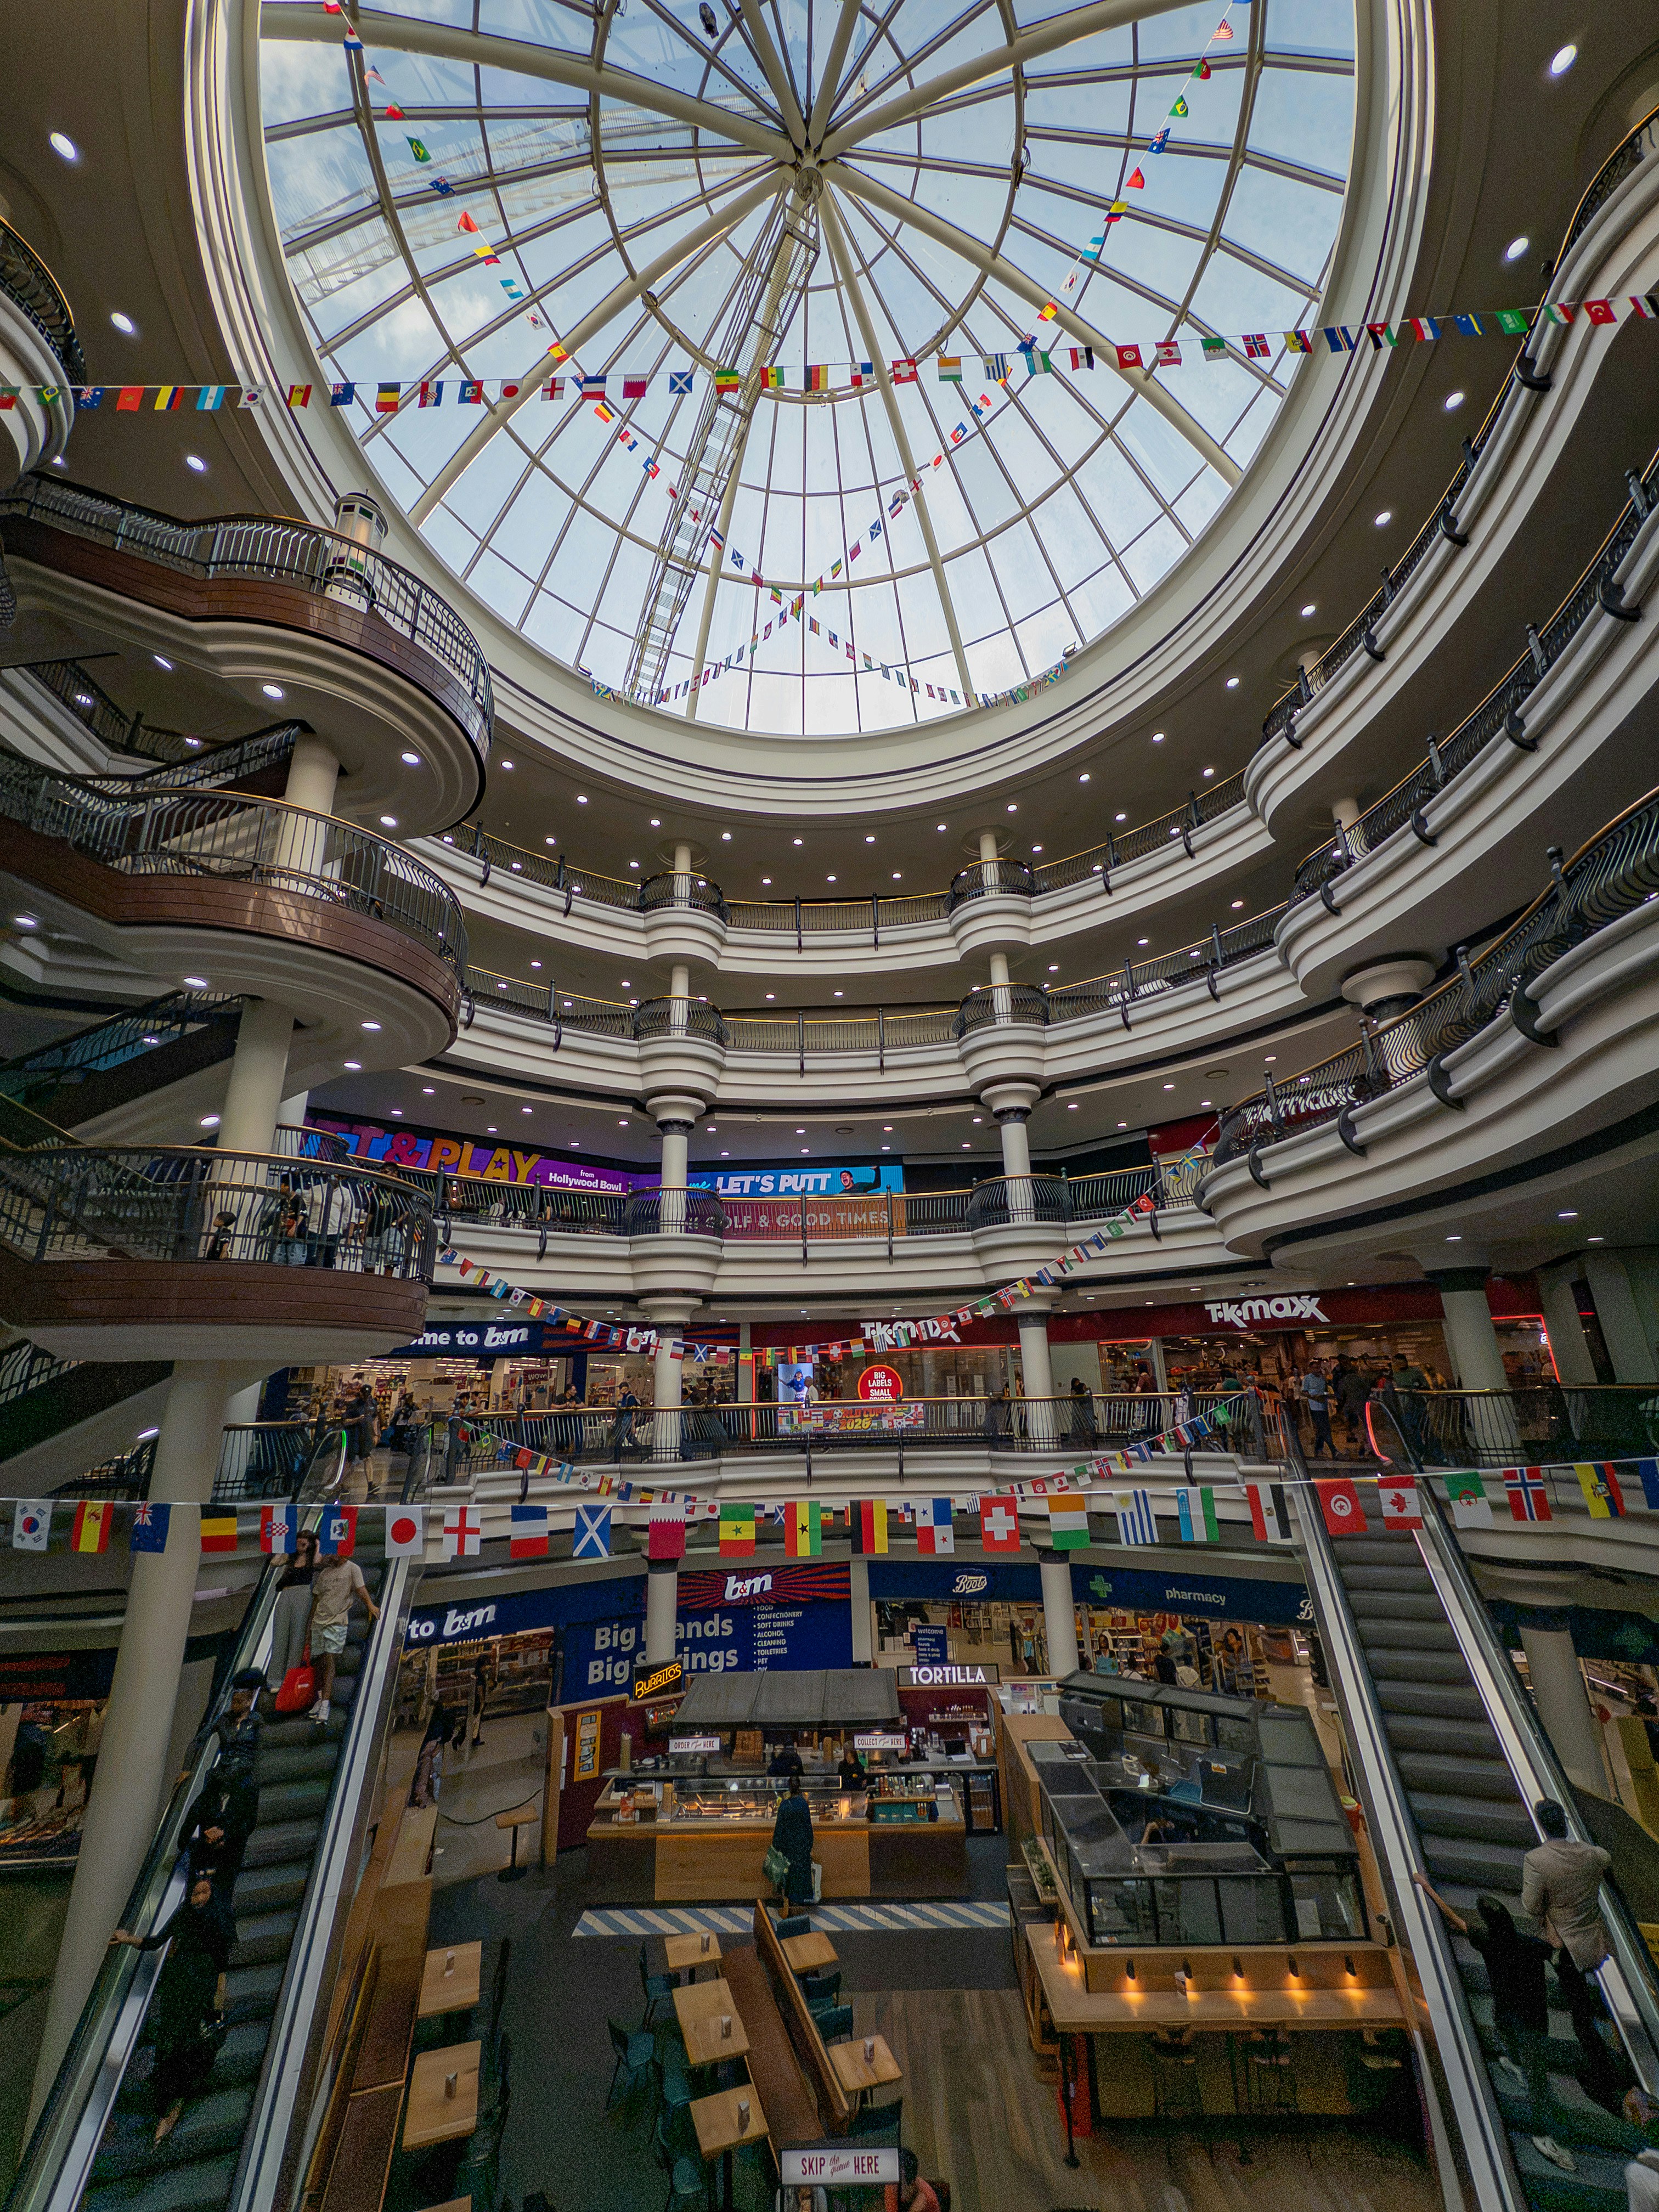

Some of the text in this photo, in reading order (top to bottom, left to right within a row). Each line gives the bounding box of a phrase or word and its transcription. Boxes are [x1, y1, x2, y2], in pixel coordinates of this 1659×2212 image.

[384, 1132, 422, 1166] &
[427, 1138, 543, 1182] PLAY
[549, 1172, 622, 1192] Hollywood Bowl
[580, 1169, 595, 1178] from
[716, 1175, 774, 1194] LET'S
[778, 1173, 831, 1192] PUTT
[776, 1213, 831, 1227] GOOD
[837, 1210, 888, 1225] TIMES
[455, 1330, 478, 1346] to
[483, 1326, 529, 1347] b&m
[868, 1379, 893, 1387] LABELS
[874, 1371, 886, 1379] BIG
[870, 1389, 891, 1397] SMALL
[861, 1407, 882, 1418] CUP
[839, 1418, 872, 1431] 2026
[725, 1574, 772, 1601] b&m
[952, 1575, 987, 1594] Boots
[1165, 1588, 1226, 1606] pharmacy
[408, 1605, 495, 1639] to b&m
[757, 1611, 803, 1620] CONFECTIONERY
[772, 1620, 794, 1628] DRINKS
[595, 1623, 636, 1651] Big
[757, 1629, 785, 1638] ALCOHOL
[757, 1638, 786, 1647] CLEANING
[757, 1647, 787, 1656] TOILETRIES
[588, 1656, 630, 1685] Big
[910, 1666, 986, 1684] TORTILLA
[635, 1663, 682, 1699] BURRITOS
[703, 1740, 715, 1748] HERE
[857, 1737, 878, 1746] COLLECT
[801, 2156, 826, 2176] SKIP
[829, 2154, 840, 2166] the
[854, 2155, 879, 2175] HERE
